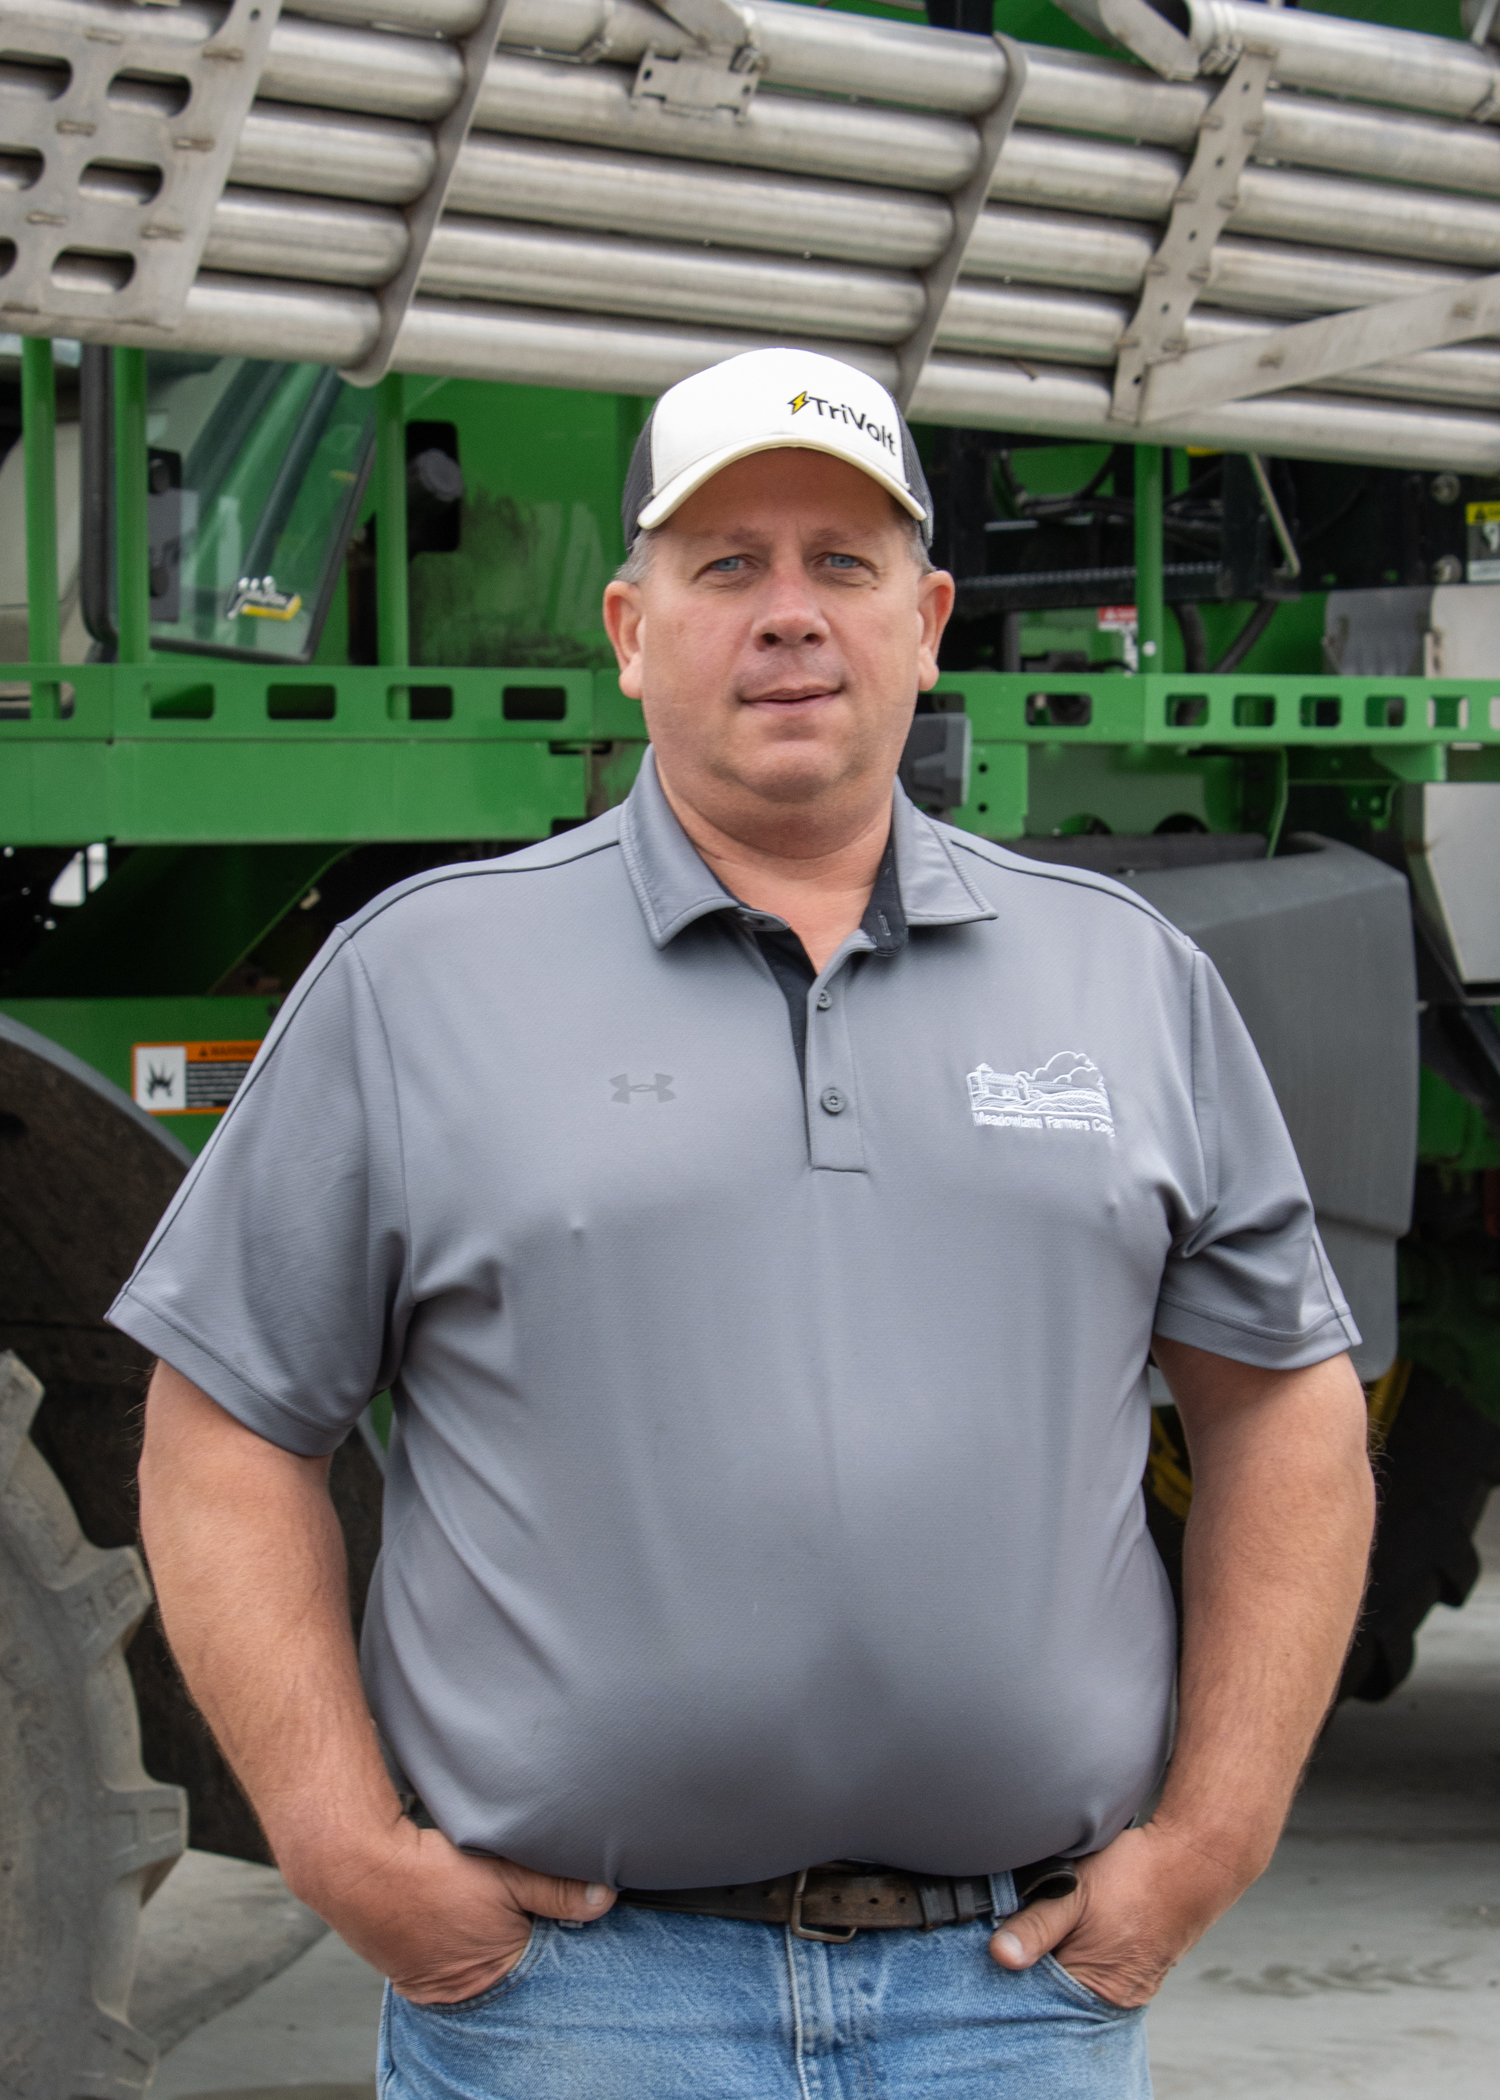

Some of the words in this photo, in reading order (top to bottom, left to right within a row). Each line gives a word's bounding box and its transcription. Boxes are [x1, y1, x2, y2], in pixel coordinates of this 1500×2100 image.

[808, 396, 896, 456] TriVolt
[972, 1111, 1043, 1128] Meadowland
[1044, 1115, 1090, 1131] Farmers
